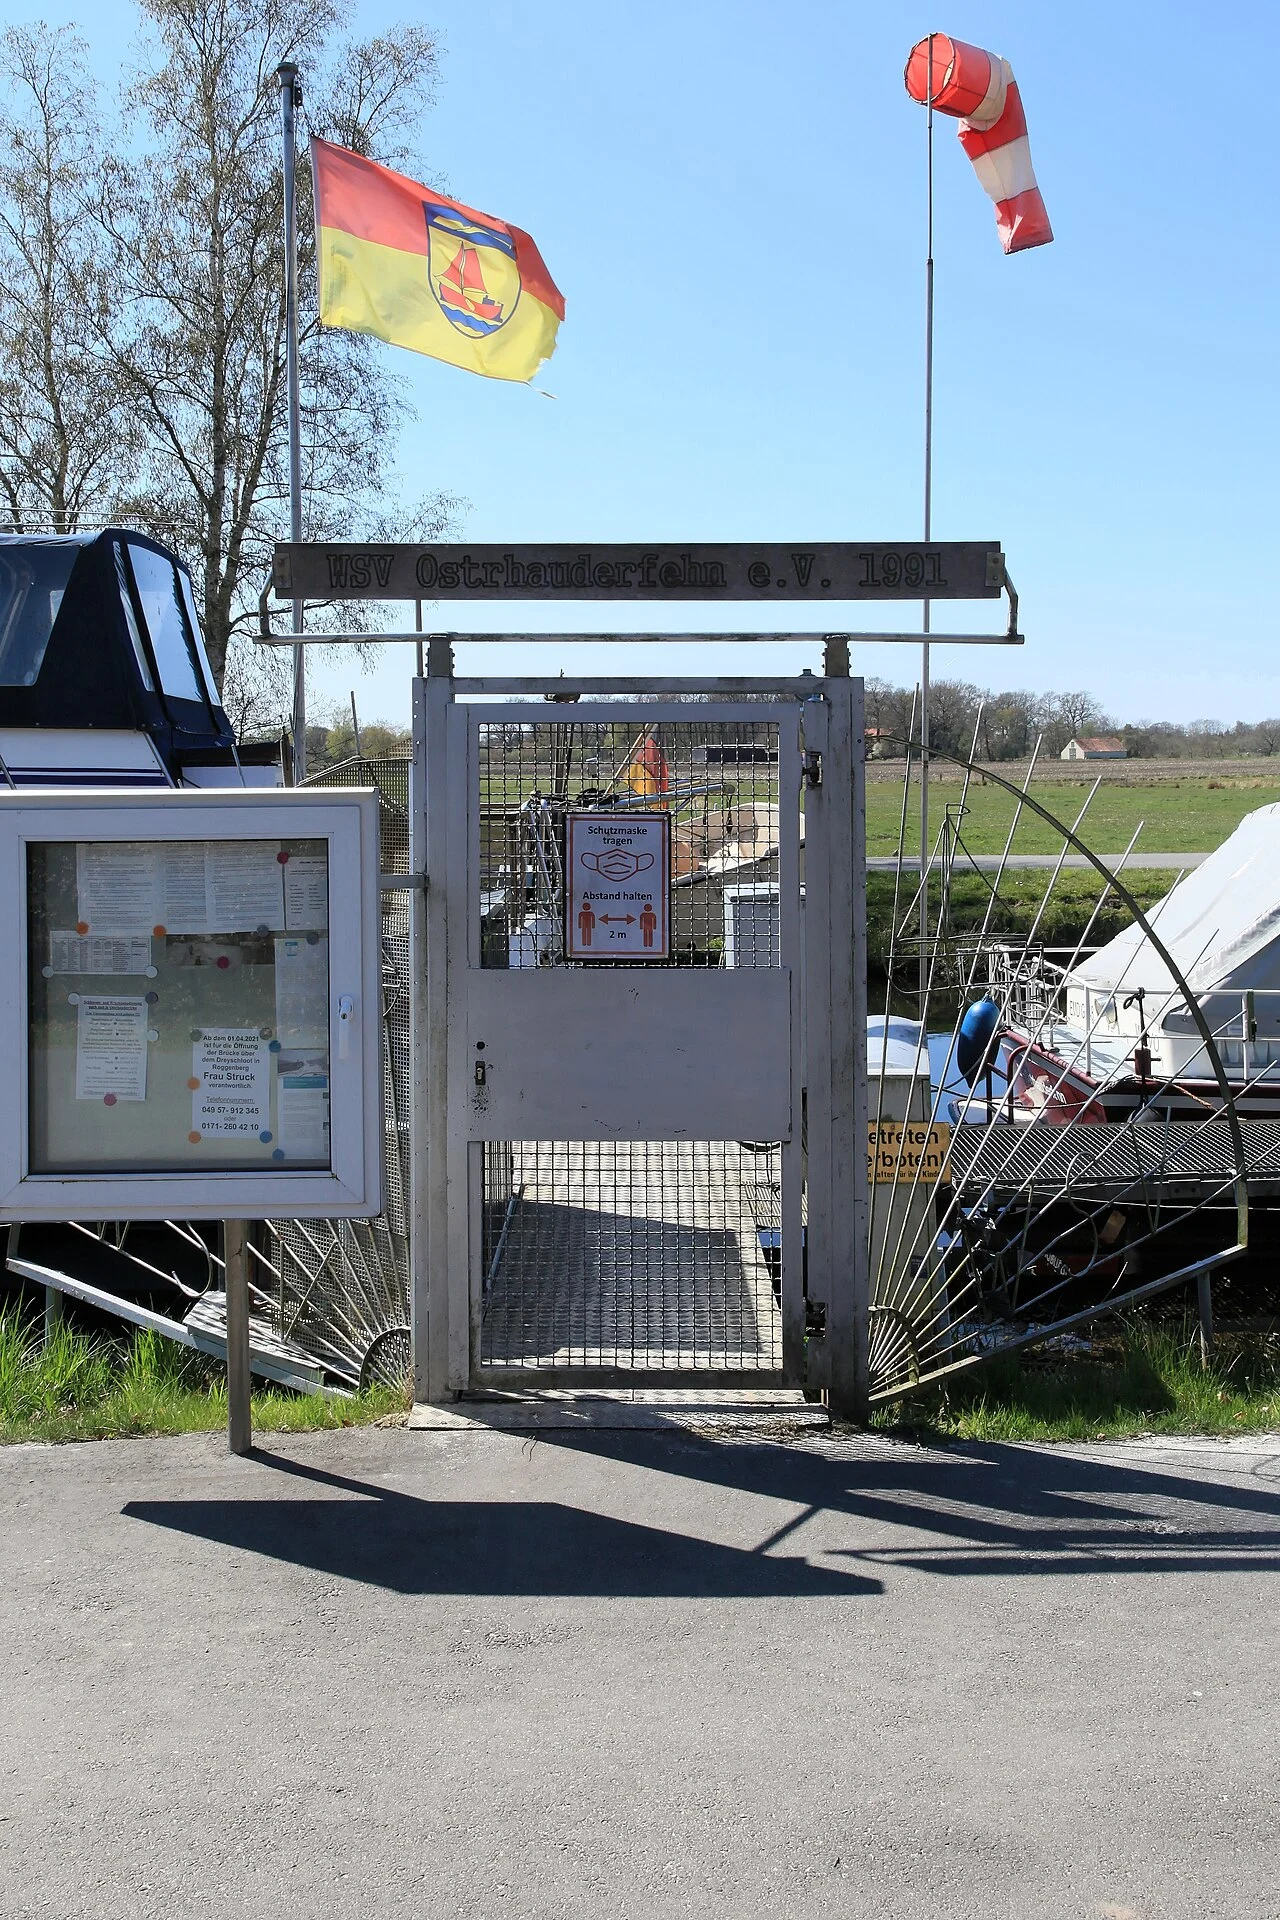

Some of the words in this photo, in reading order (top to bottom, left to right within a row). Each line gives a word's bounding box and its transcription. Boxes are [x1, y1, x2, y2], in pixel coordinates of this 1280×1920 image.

[326, 553, 394, 588] WSV
[416, 553, 727, 588] Ostrhauderfehn
[748, 552, 831, 588] e.V.
[859, 552, 948, 587] 1991
[588, 826, 648, 835] Schutzmaske
[603, 837, 633, 846] tragen
[582, 892, 621, 900] Abstand
[623, 892, 653, 901] halten
[609, 931, 615, 939] 2
[233, 1042, 259, 1050] Öffnung
[212, 1064, 249, 1072] Roggenberg
[203, 1072, 224, 1080] Frau
[226, 1072, 256, 1081] Struck
[250, 1123, 259, 1131] 10
[868, 1129, 939, 1145] etreten
[867, 1151, 944, 1168] erboten!
